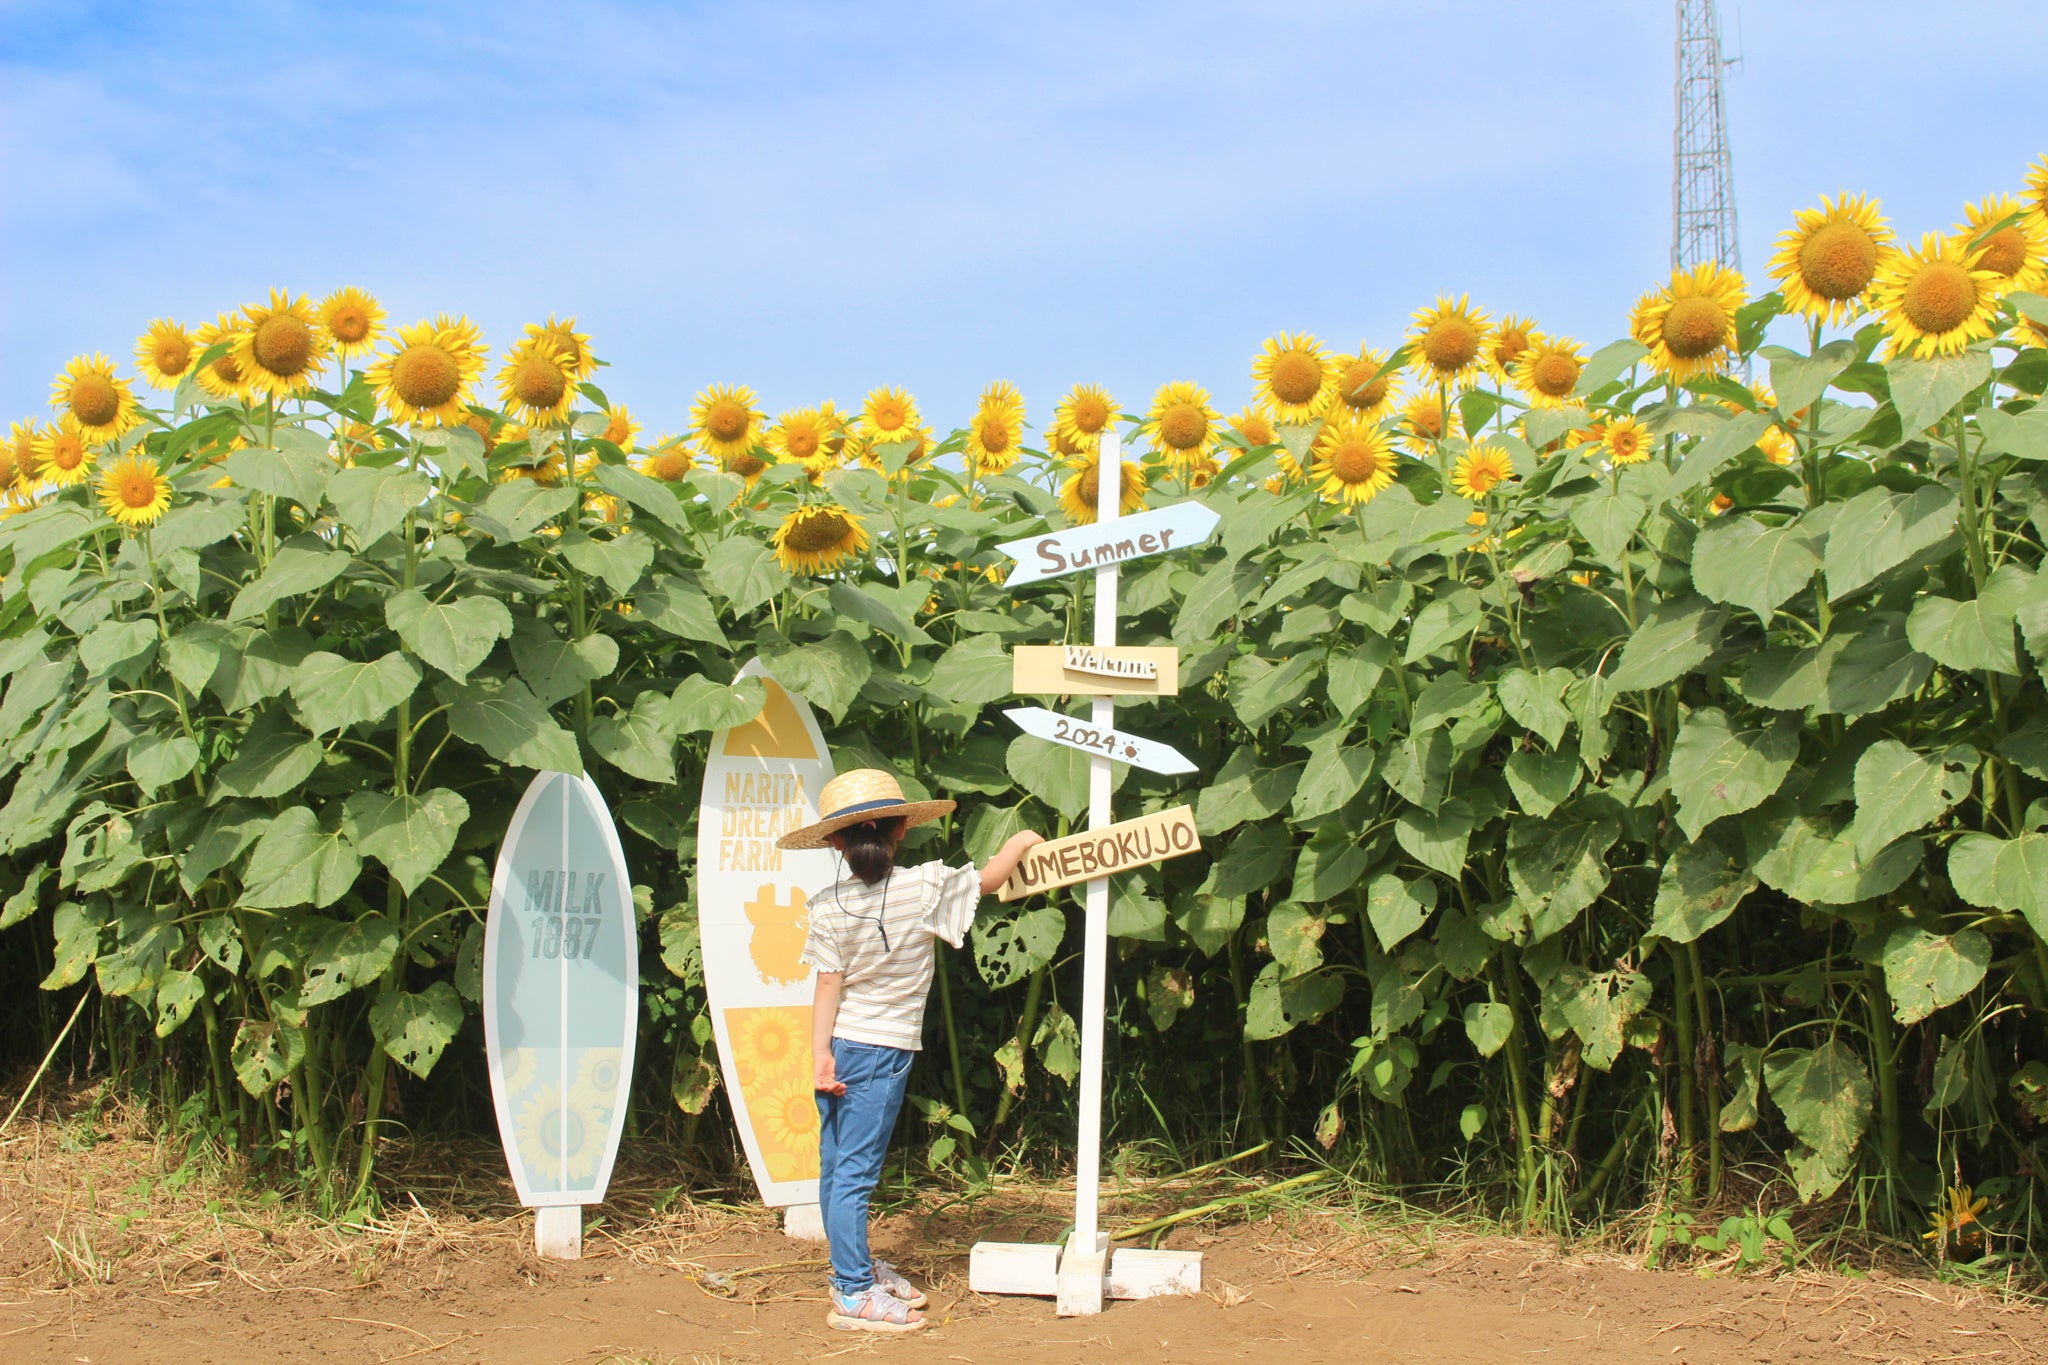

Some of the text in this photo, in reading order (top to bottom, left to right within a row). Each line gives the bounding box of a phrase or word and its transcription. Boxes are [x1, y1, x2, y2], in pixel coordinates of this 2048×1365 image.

[1036, 528, 1174, 574] Summer
[1063, 645, 1157, 680] Welcome
[1054, 719, 1116, 754] 2024
[725, 772, 807, 805] NARITA
[722, 805, 803, 838] DREAM
[719, 840, 783, 872] FARM
[524, 869, 606, 914] MILK
[531, 916, 602, 960] 1887
